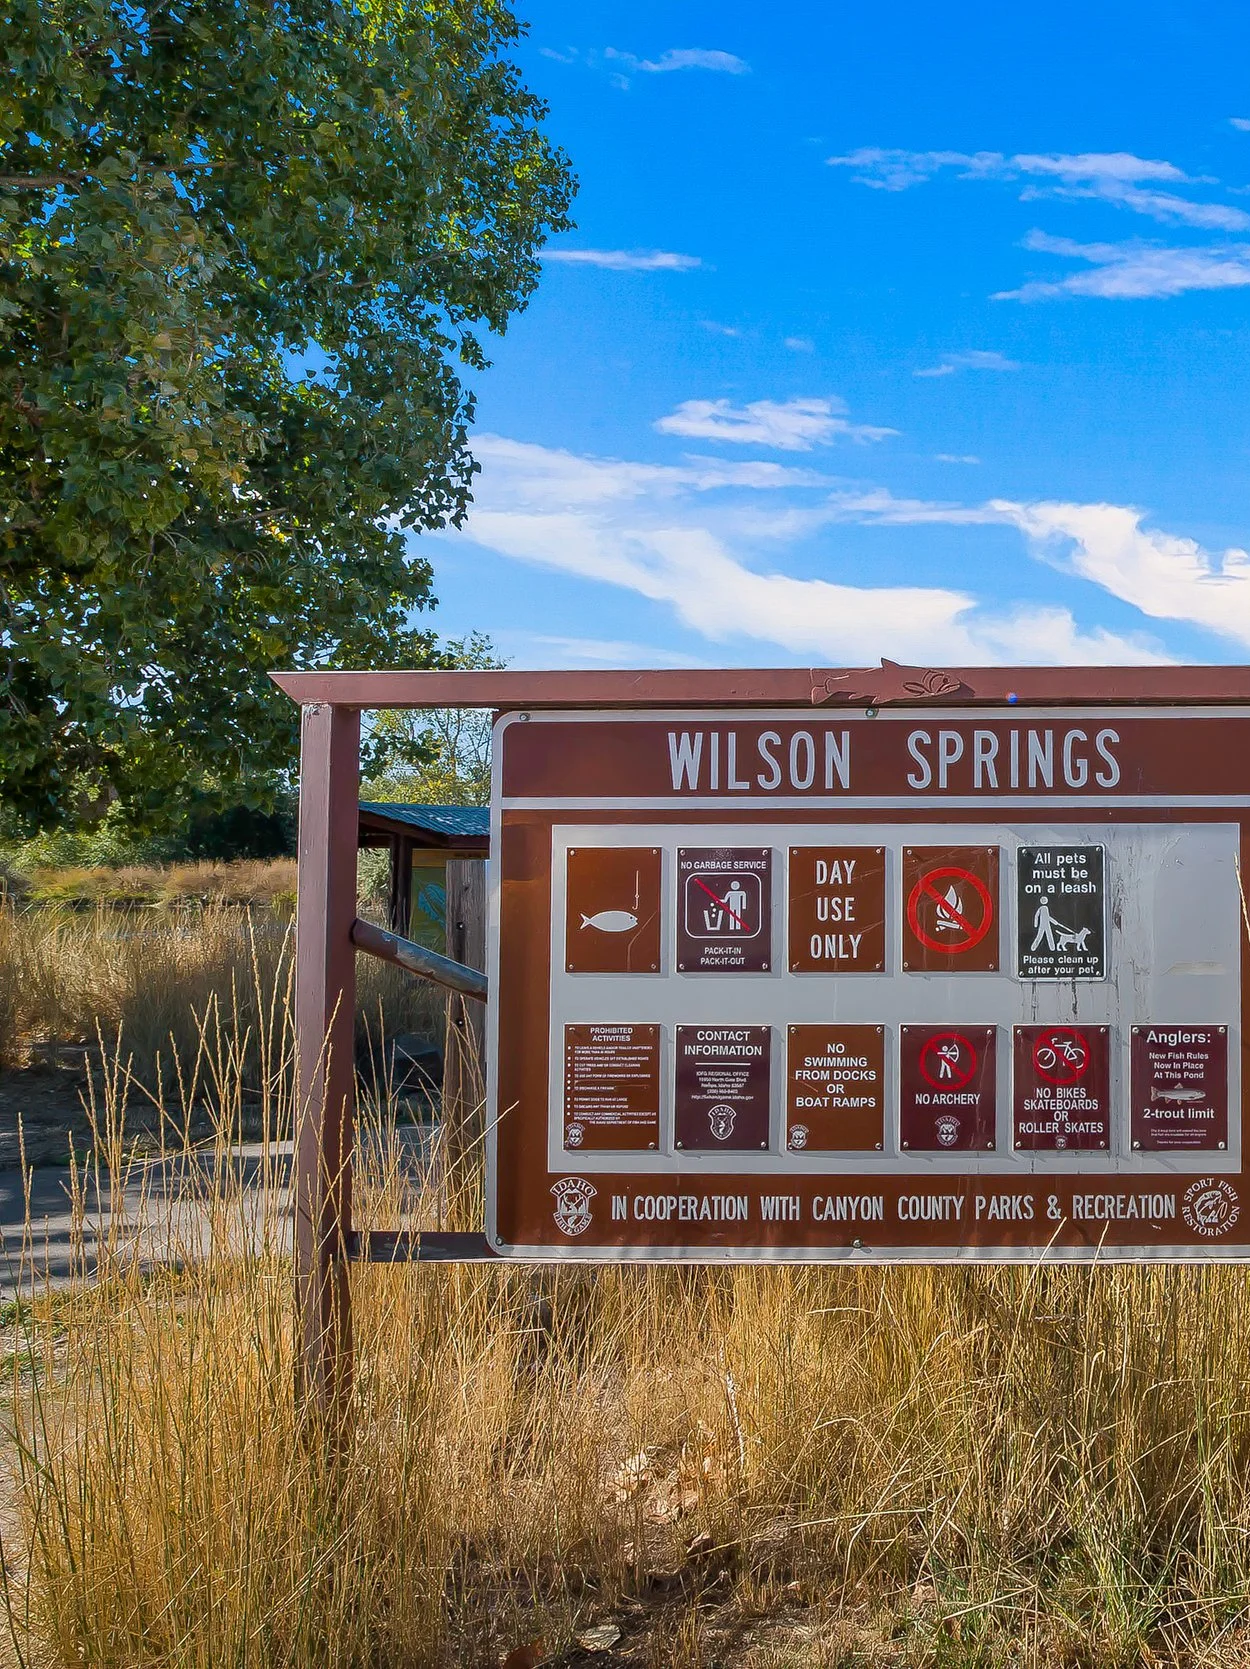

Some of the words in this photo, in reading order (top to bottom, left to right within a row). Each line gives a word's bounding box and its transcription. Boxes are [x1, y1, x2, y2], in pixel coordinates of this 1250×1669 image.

[667, 730, 850, 790] WILSON
[907, 728, 1121, 790] SPRINGS
[680, 861, 693, 870] NO
[693, 860, 733, 870] GARBAGE
[733, 860, 767, 870] SERVICE
[1034, 852, 1051, 865] All
[1056, 852, 1087, 867] pets
[816, 859, 856, 885] DAY
[1032, 867, 1066, 879] must
[1071, 866, 1089, 880] be
[1024, 884, 1042, 894] on
[1047, 884, 1056, 894] a
[1061, 881, 1097, 894] leash
[817, 896, 856, 922] USE
[704, 946, 742, 955] PACK-IT-IN
[810, 933, 862, 959] ONLY
[700, 957, 746, 965] PACK-IT-OUT
[1023, 955, 1055, 964] Please
[1057, 955, 1084, 964] clean
[1086, 956, 1099, 966] up
[1027, 965, 1051, 975] after
[1053, 966, 1075, 976] your
[1078, 965, 1095, 975] pet
[591, 1034, 631, 1042] ACTIVITIES
[696, 1030, 751, 1042] CONTACT
[1146, 1029, 1211, 1047] Anglers:
[684, 1044, 762, 1056] INFORMATION
[827, 1043, 845, 1054] NO
[1148, 1052, 1167, 1060] New
[1167, 1051, 1185, 1060] Fish
[1186, 1052, 1209, 1060] Rules
[804, 1056, 868, 1068] SWIMMING
[1153, 1061, 1172, 1070] Now
[1173, 1061, 1181, 1069] In
[1182, 1061, 1205, 1070] Place
[795, 1070, 830, 1081] FROM
[833, 1070, 877, 1081] DOCKS
[1153, 1071, 1163, 1079] At
[1164, 1071, 1182, 1079] This
[1183, 1071, 1205, 1079] Pond
[826, 1083, 845, 1094] OR
[1036, 1087, 1052, 1099] NO
[1056, 1087, 1087, 1099] BIKES
[795, 1096, 831, 1108] BOAT
[832, 1096, 876, 1108] RAMPS
[915, 1093, 931, 1105] NO
[931, 1093, 981, 1105] ARCHERY
[1023, 1098, 1099, 1111] SKATEBOARDS
[1053, 1110, 1069, 1122] OR
[1143, 1108, 1185, 1119] 2-trout
[1188, 1108, 1215, 1119] limit
[1018, 1122, 1060, 1134] ROLLER
[1064, 1121, 1104, 1134] SKATES
[551, 1178, 595, 1196] IDAHO
[1182, 1176, 1216, 1203] SPORT
[1217, 1179, 1240, 1203] FISH
[611, 1195, 627, 1221] IN
[633, 1195, 748, 1221] COOPERATION
[759, 1195, 800, 1221] WITH
[812, 1195, 884, 1221] CANYON
[897, 1195, 965, 1221] COUNTY
[975, 1194, 1034, 1221] PARKS
[1046, 1194, 1062, 1220] &
[1072, 1194, 1176, 1220] RECREATION
[1180, 1204, 1242, 1237] RESTORATION
